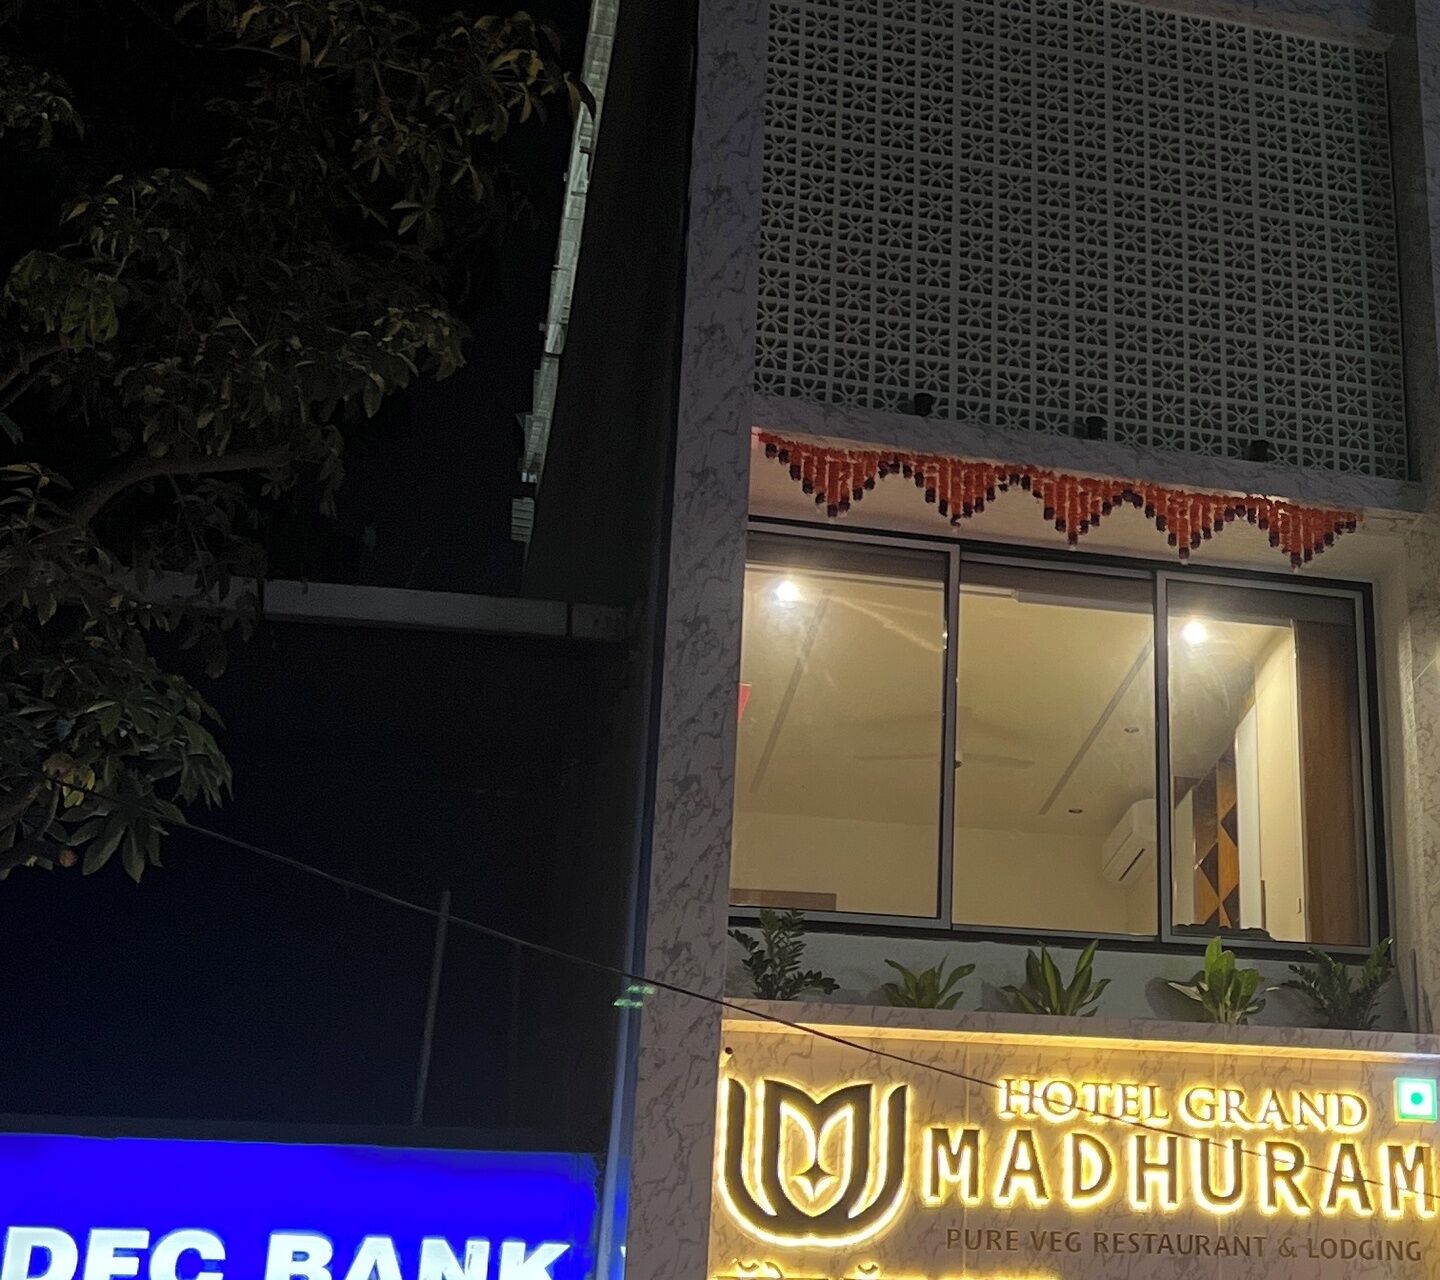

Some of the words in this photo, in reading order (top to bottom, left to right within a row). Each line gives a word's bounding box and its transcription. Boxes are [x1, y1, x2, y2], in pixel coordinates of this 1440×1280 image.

[1001, 1078, 1168, 1120] HOTEL
[1185, 1086, 1368, 1128] GRAND
[928, 1127, 1436, 1214] MADHURAM
[946, 1229, 1018, 1251] PURE
[1030, 1231, 1082, 1253] VEG
[1094, 1232, 1267, 1258] RESTAURANT
[1278, 1237, 1298, 1258] &
[1308, 1237, 1423, 1263] LODGING
